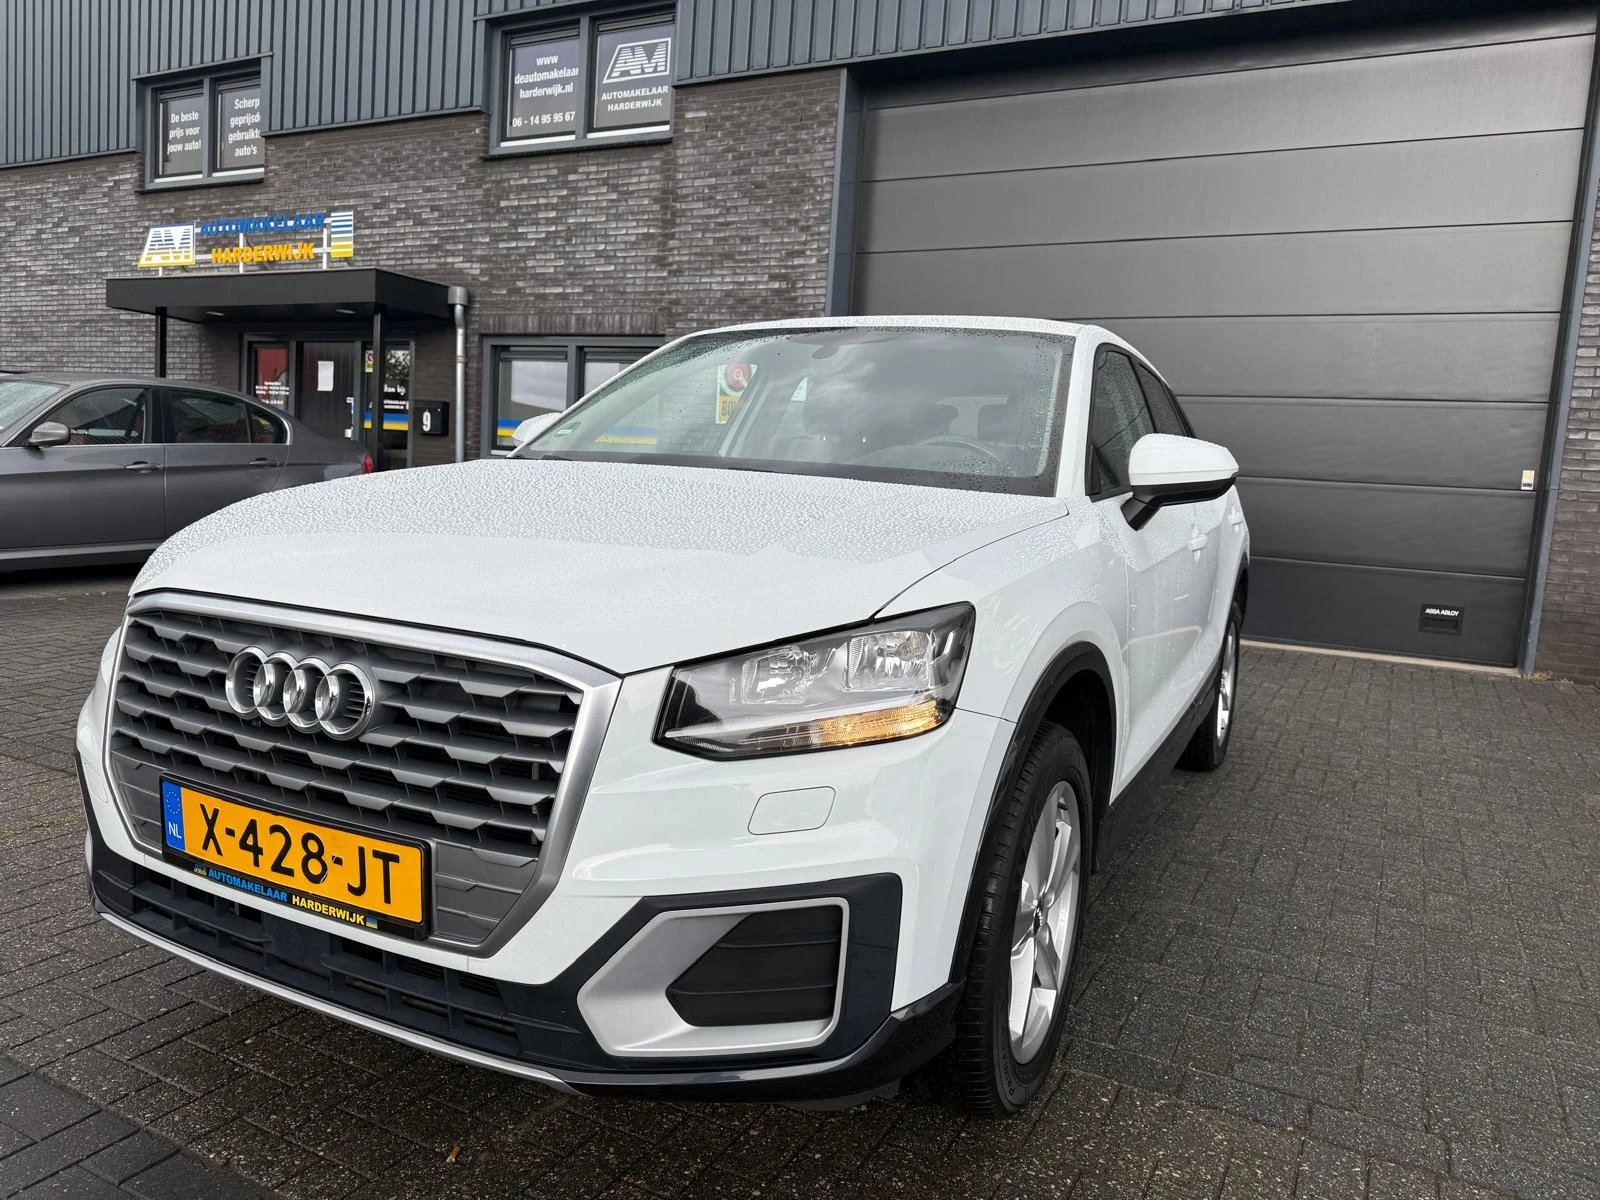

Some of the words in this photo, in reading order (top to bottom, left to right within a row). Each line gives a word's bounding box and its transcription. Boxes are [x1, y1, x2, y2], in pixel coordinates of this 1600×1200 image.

[536, 55, 559, 66] www
[519, 82, 574, 99] harderwijk.nl
[601, 85, 669, 101] AUTOMAKELAAR
[234, 98, 260, 110] Scherp
[607, 98, 663, 112] HARDERWIJK
[170, 113, 180, 123] De
[181, 111, 199, 122] beste
[512, 117, 522, 127] 06
[530, 115, 540, 125] 14
[541, 114, 551, 124] 95
[553, 112, 564, 122] 95
[565, 111, 576, 122] 67
[169, 128, 184, 140] prijs
[185, 127, 200, 136] voor
[167, 144, 183, 154] jouw
[184, 140, 202, 150] auto!
[234, 144, 258, 156] auto's
[200, 212, 326, 237] AUTOMAKELAAR
[211, 243, 315, 264] HARDERWIJK
[422, 411, 432, 432] 9
[168, 821, 182, 839] NL
[200, 803, 400, 904] X-428-JT
[208, 867, 287, 903] AUTOMAKELAAR
[292, 894, 365, 926] HARDERWIJK
